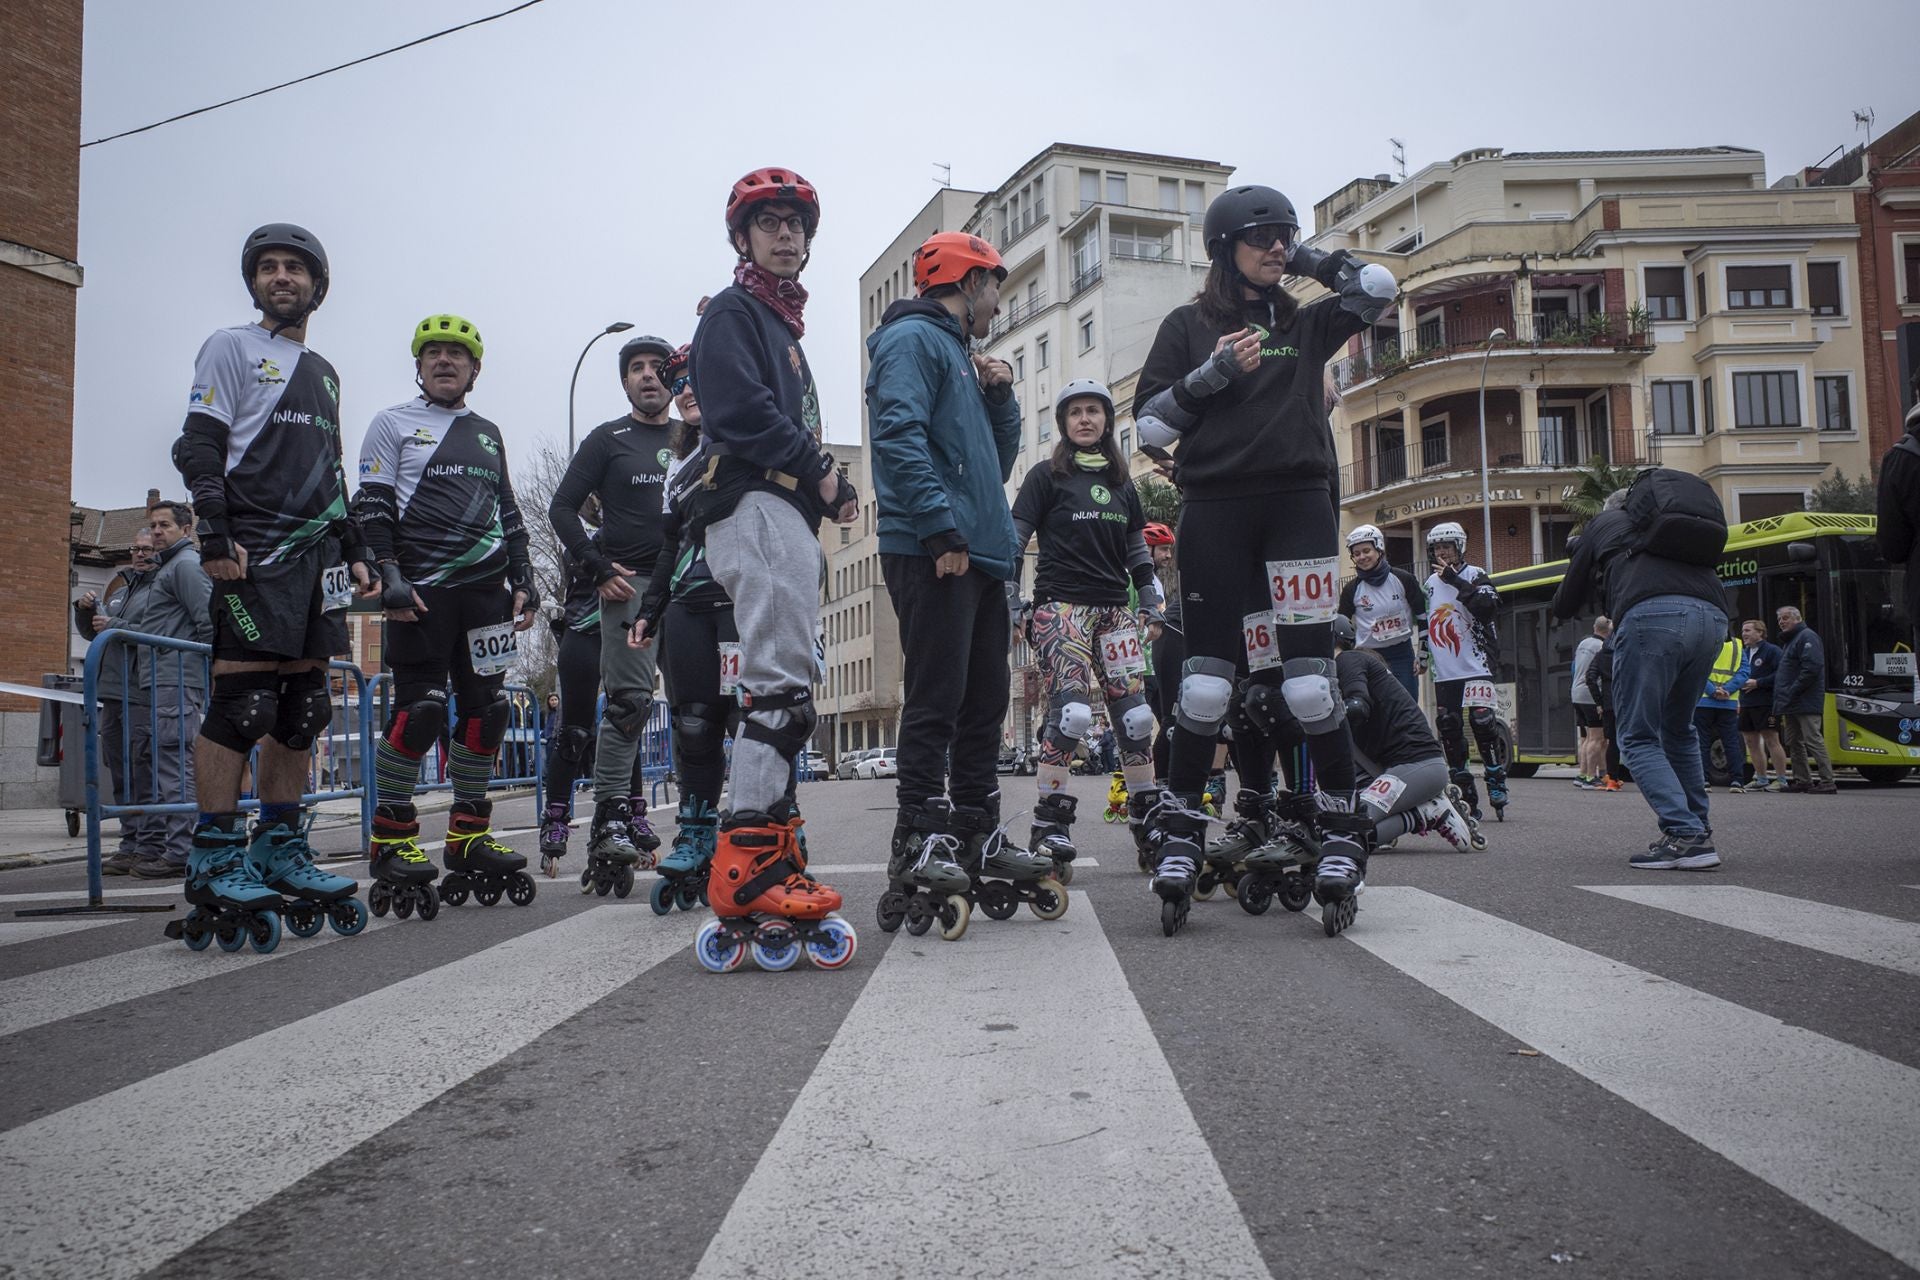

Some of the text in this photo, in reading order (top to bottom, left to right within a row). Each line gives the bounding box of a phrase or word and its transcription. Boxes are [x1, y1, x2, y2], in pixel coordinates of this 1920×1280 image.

[1260, 346, 1300, 357] ADAJOZ
[273, 410, 312, 425] INLINE
[427, 464, 465, 478] INLINE
[632, 473, 665, 485] INLINE
[1072, 510, 1100, 521] INLINE
[1715, 557, 1758, 578] ctrico
[1272, 571, 1333, 602] 3101
[224, 593, 261, 642] ADIZERO
[473, 631, 517, 659] 3022
[1246, 624, 1270, 651] 26
[721, 653, 739, 676] 31
[1843, 675, 1864, 687] 432
[1465, 684, 1492, 699] 3113
[1370, 779, 1391, 795] 20
